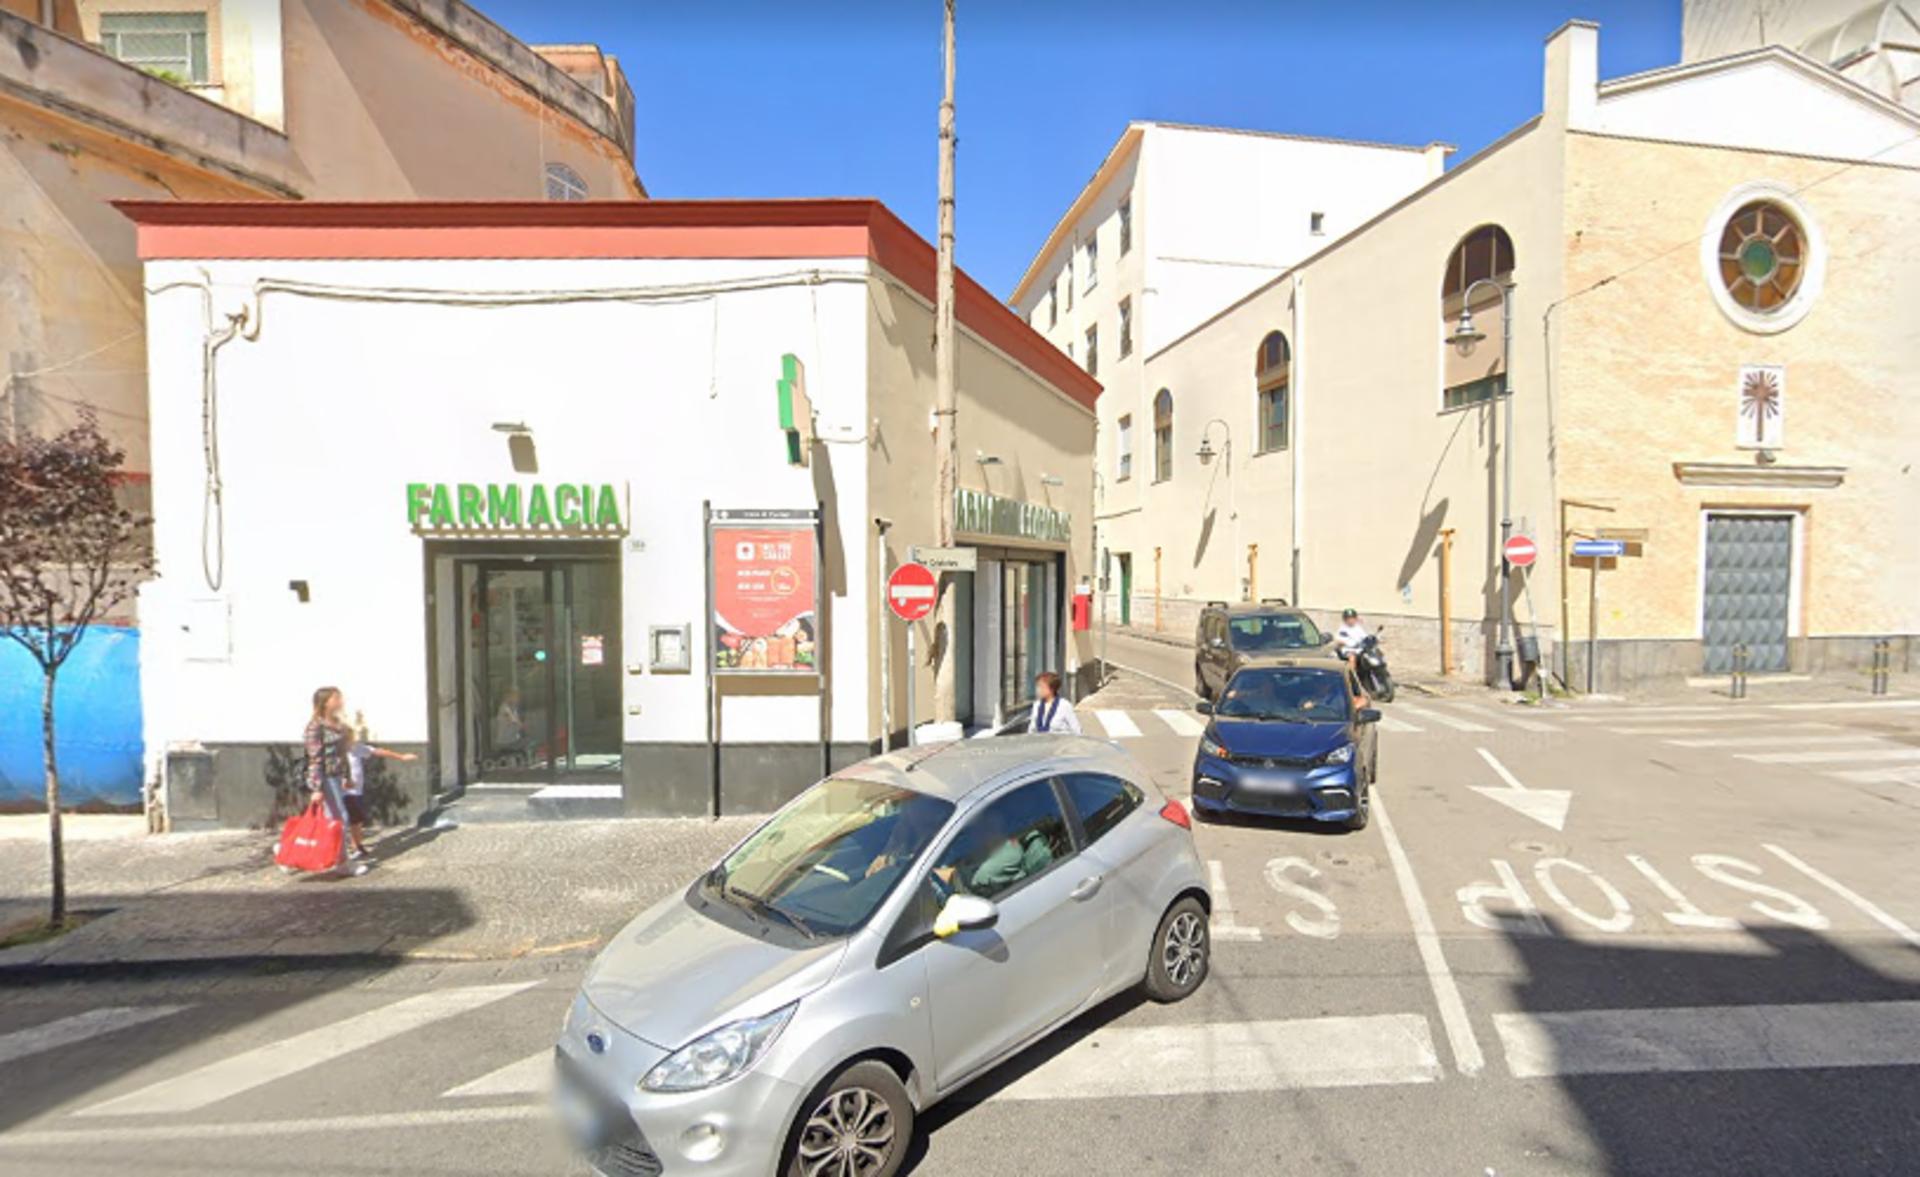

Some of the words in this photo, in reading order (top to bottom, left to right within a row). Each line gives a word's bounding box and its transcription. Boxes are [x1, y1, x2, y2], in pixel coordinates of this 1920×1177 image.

[406, 482, 620, 525] FARMACIA
[1207, 856, 1341, 941] ST
[1456, 854, 1831, 935] STOP
